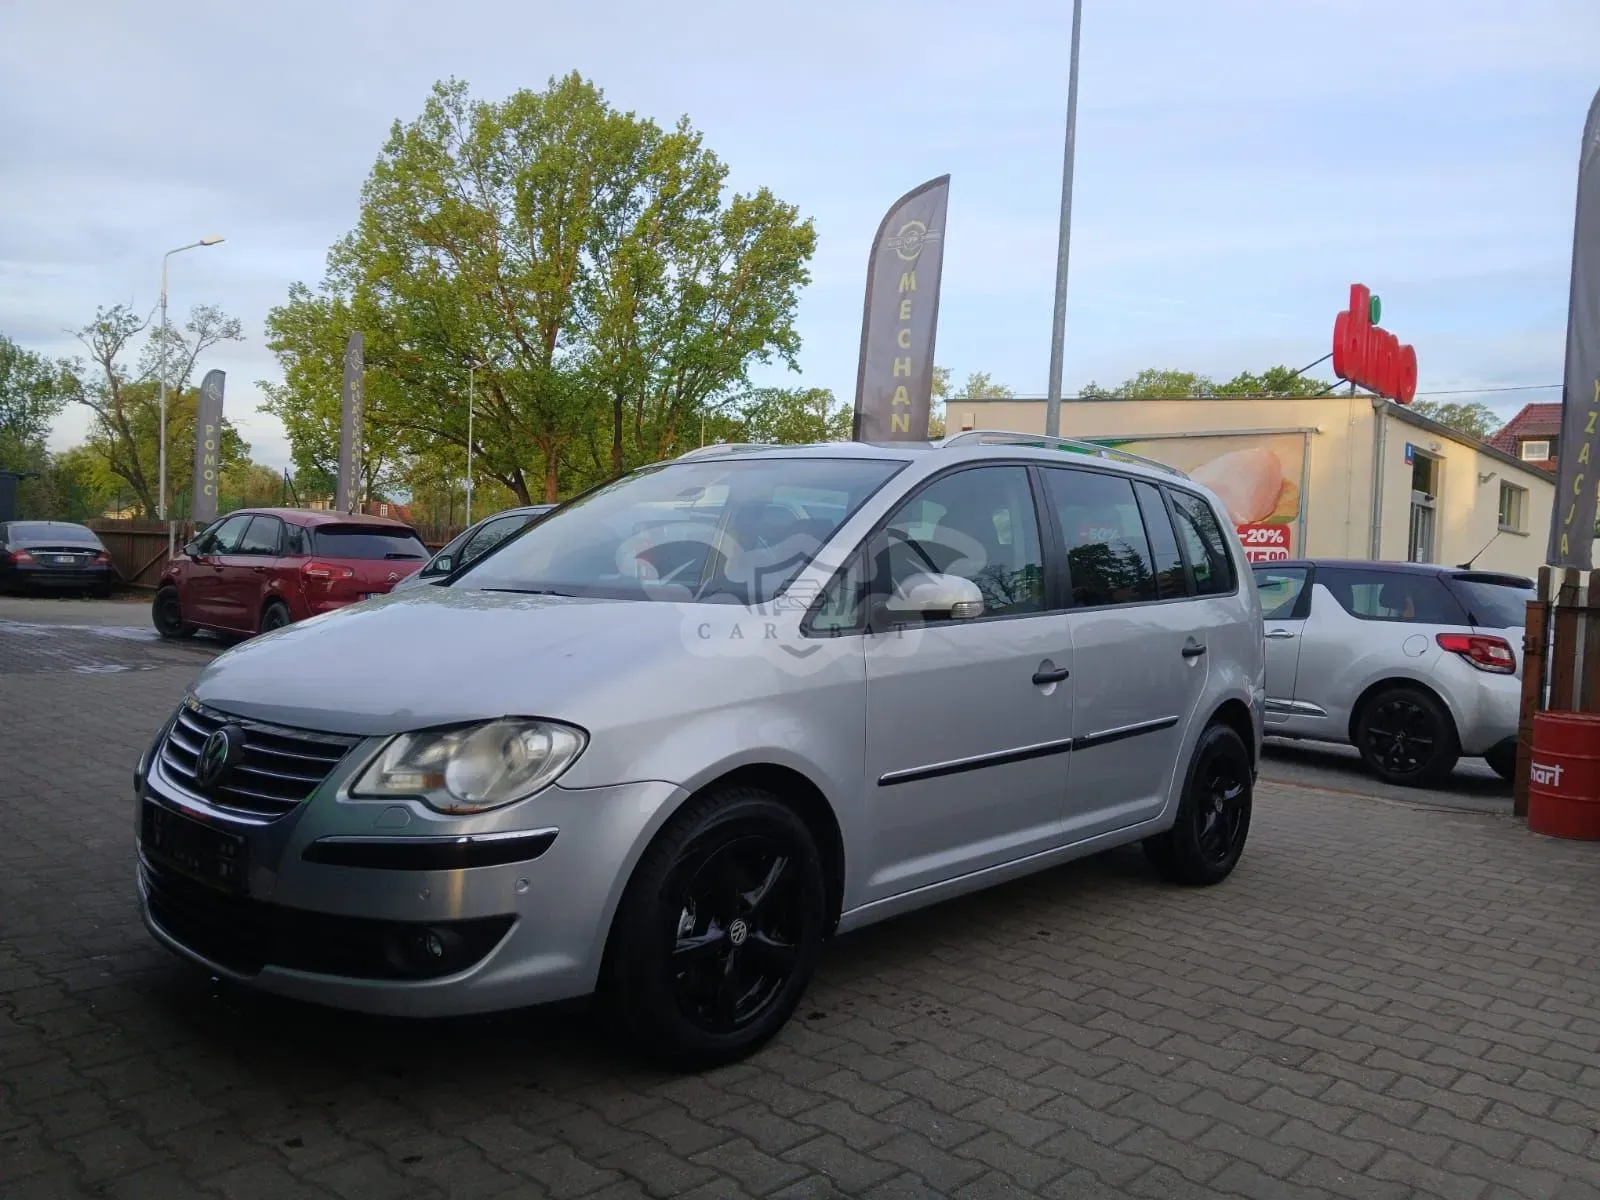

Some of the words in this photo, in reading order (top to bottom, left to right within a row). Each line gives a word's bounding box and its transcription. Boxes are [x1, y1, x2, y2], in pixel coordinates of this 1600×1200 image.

[890, 270, 917, 434] MECHAN
[203, 424, 215, 496] POMOC
[1238, 528, 1284, 544] -20%
